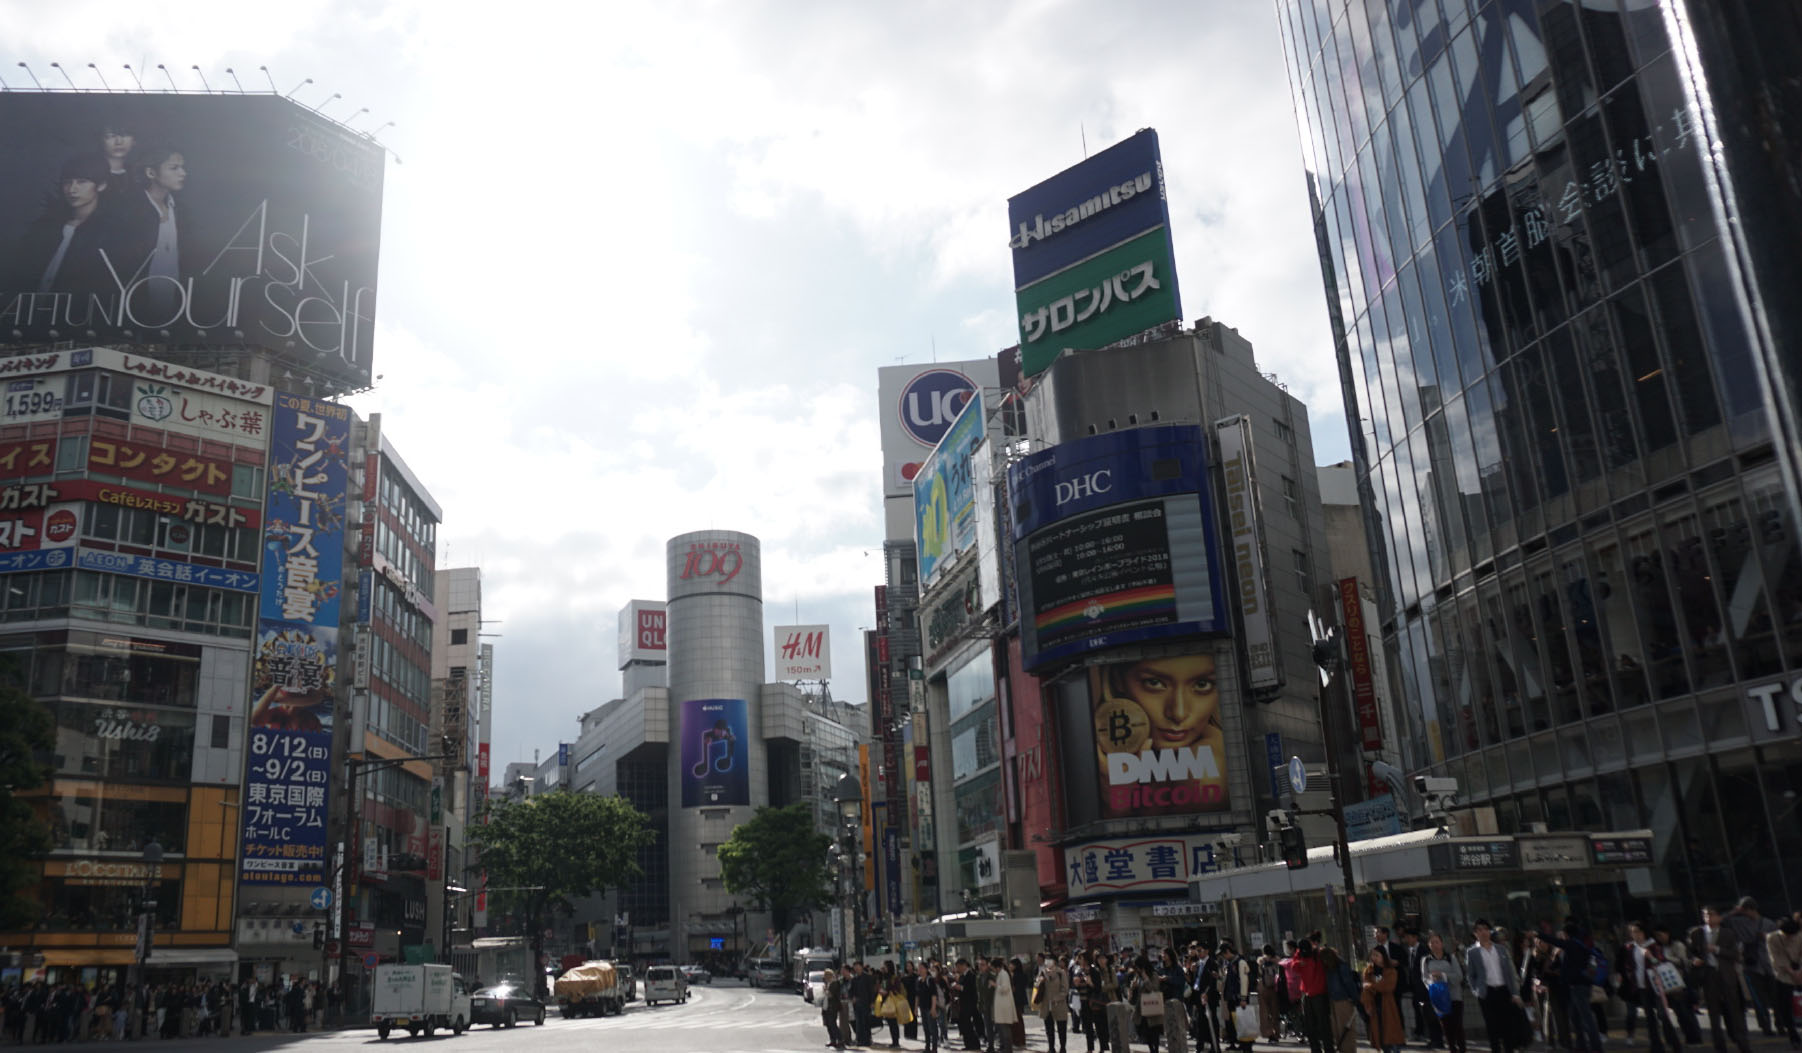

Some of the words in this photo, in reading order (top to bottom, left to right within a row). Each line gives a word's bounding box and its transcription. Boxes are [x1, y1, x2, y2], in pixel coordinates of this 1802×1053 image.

[1009, 171, 1152, 248] Hisamitsu
[203, 199, 336, 304] Ask
[99, 247, 374, 362] Yourself
[1022, 260, 1160, 342] サロンパス
[180, 397, 263, 435] しゃぶ葉
[90, 441, 227, 485] コンタクト
[1, 484, 58, 510] ガスト
[1054, 470, 1113, 507] DHC
[184, 500, 247, 530] ガスト
[85, 552, 127, 569] AEON
[680, 551, 743, 585] 109
[643, 614, 664, 629] UN
[642, 632, 667, 648] QL
[781, 631, 823, 660] H&M
[1747, 678, 1802, 731] T
[1107, 745, 1220, 786] DMM
[247, 783, 325, 808] 東京国際
[1110, 781, 1221, 810] Bitcoin
[247, 806, 323, 829] フォーラム
[404, 898, 425, 920] LUSH
